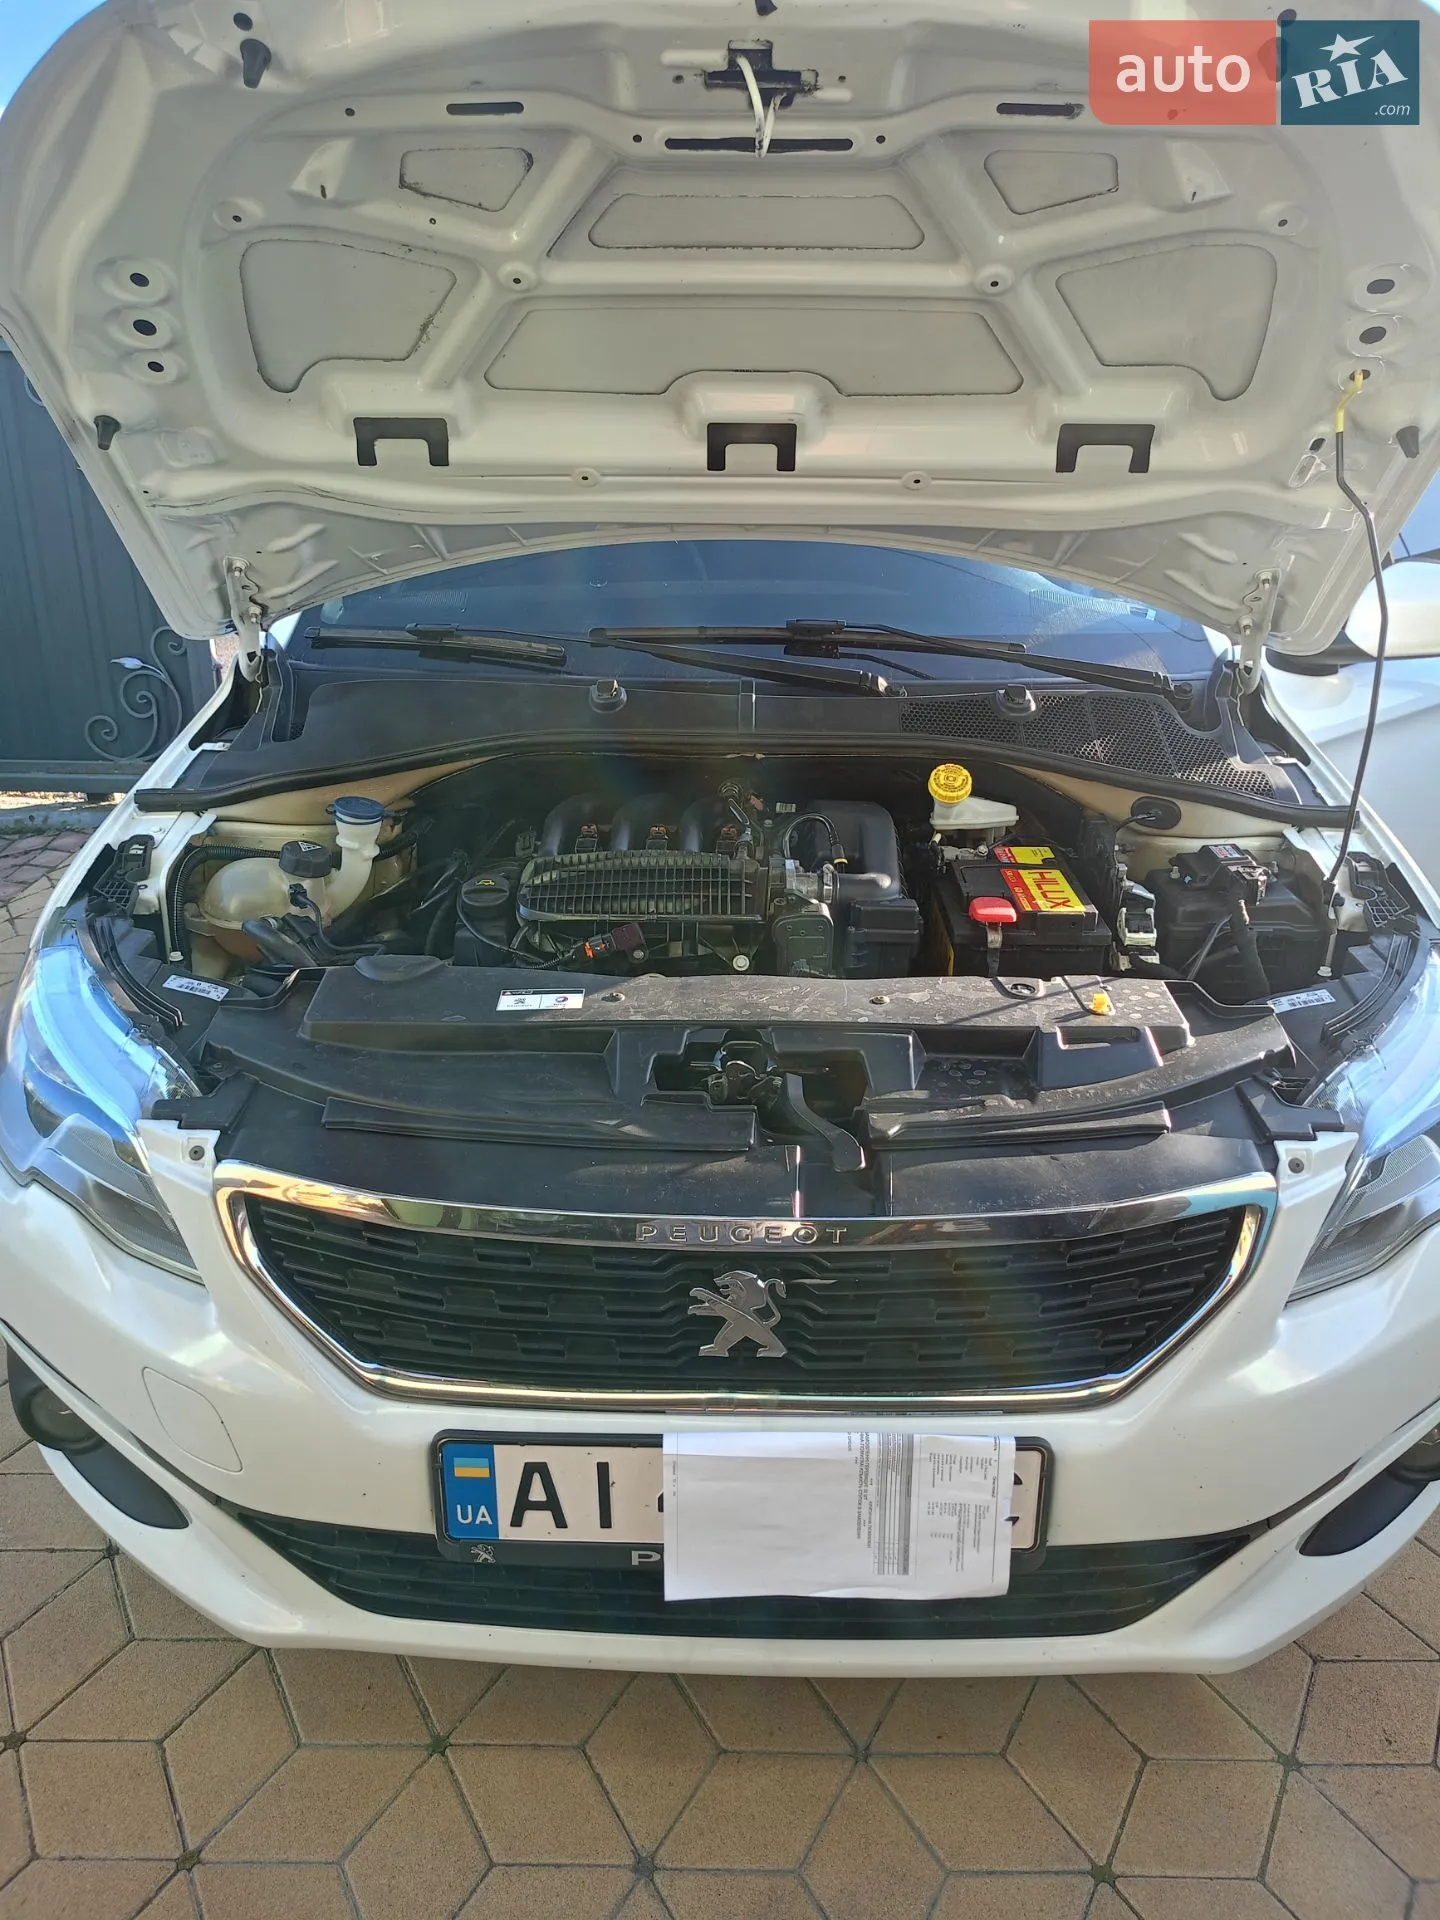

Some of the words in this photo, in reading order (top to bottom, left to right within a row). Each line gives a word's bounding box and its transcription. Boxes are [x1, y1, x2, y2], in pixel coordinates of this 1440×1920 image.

[635, 1223, 848, 1246] PEUGEOT
[509, 1461, 613, 1529] AI
[456, 1504, 493, 1525] UA
